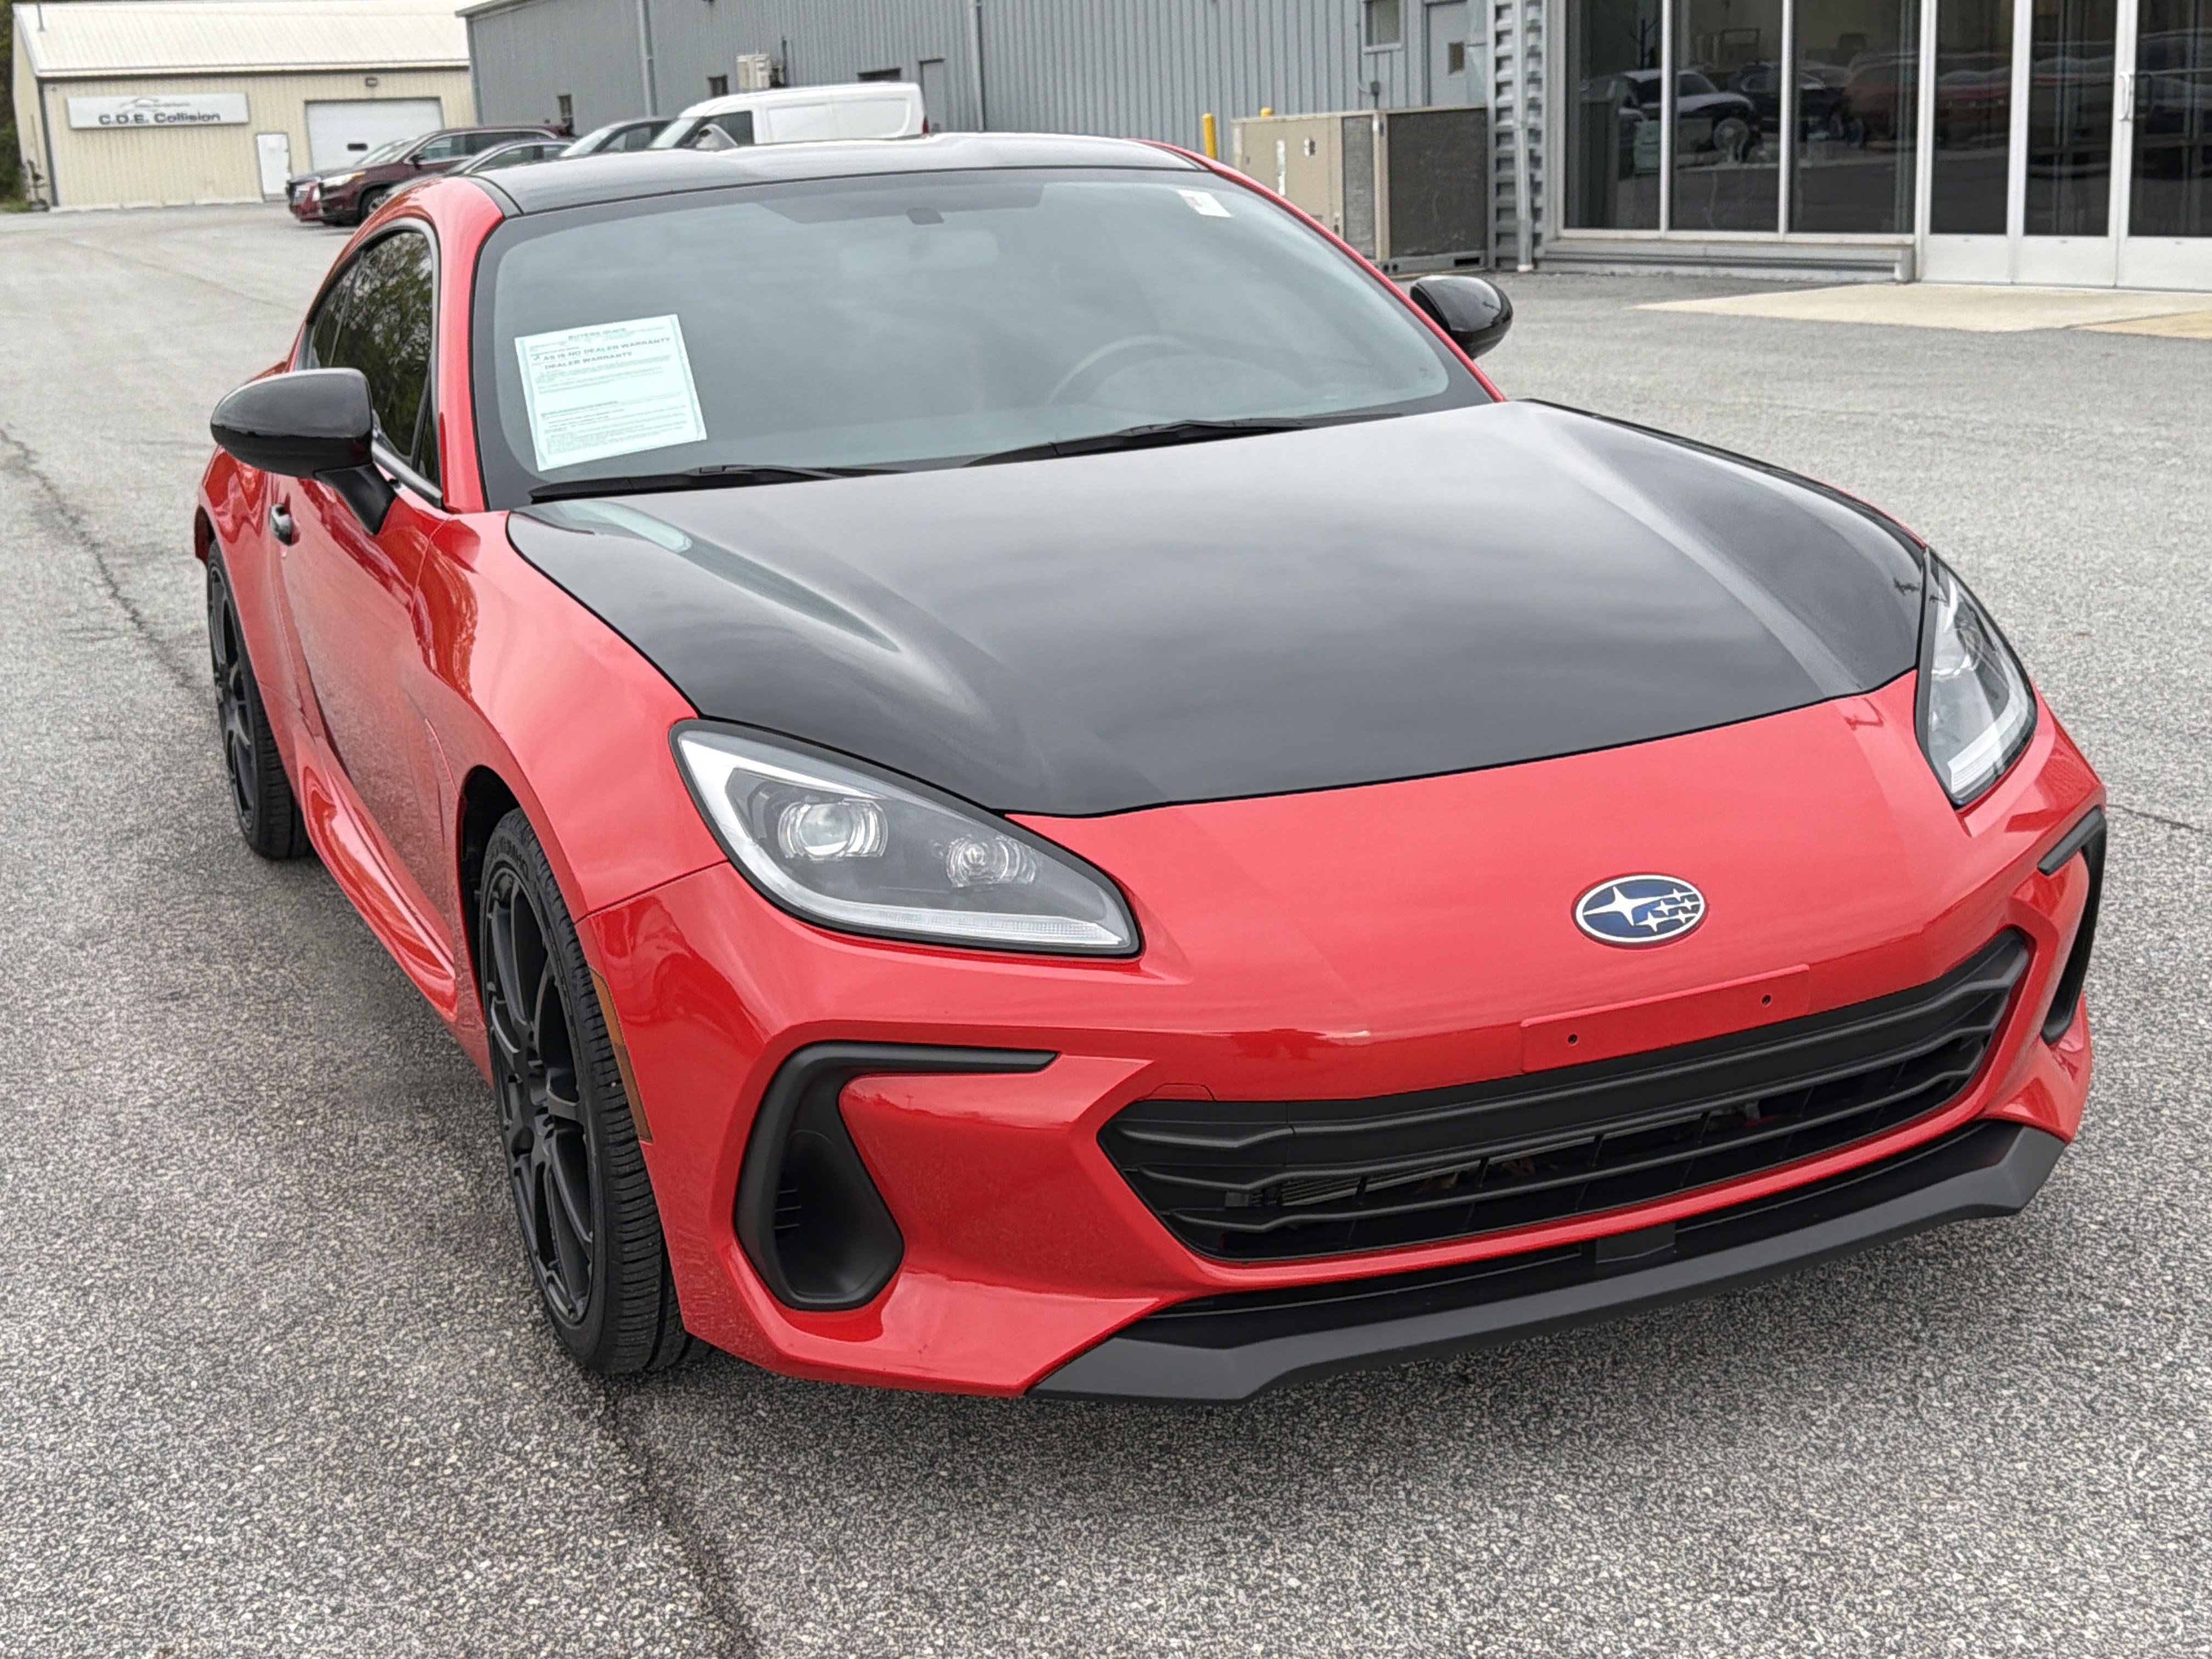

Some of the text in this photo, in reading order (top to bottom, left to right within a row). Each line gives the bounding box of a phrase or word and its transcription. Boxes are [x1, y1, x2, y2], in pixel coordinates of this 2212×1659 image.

[154, 110, 221, 123] Collision
[583, 345, 619, 355] DEALER
[620, 337, 670, 349] WARRANTY
[545, 351, 633, 370] DEALER WARRANTY
